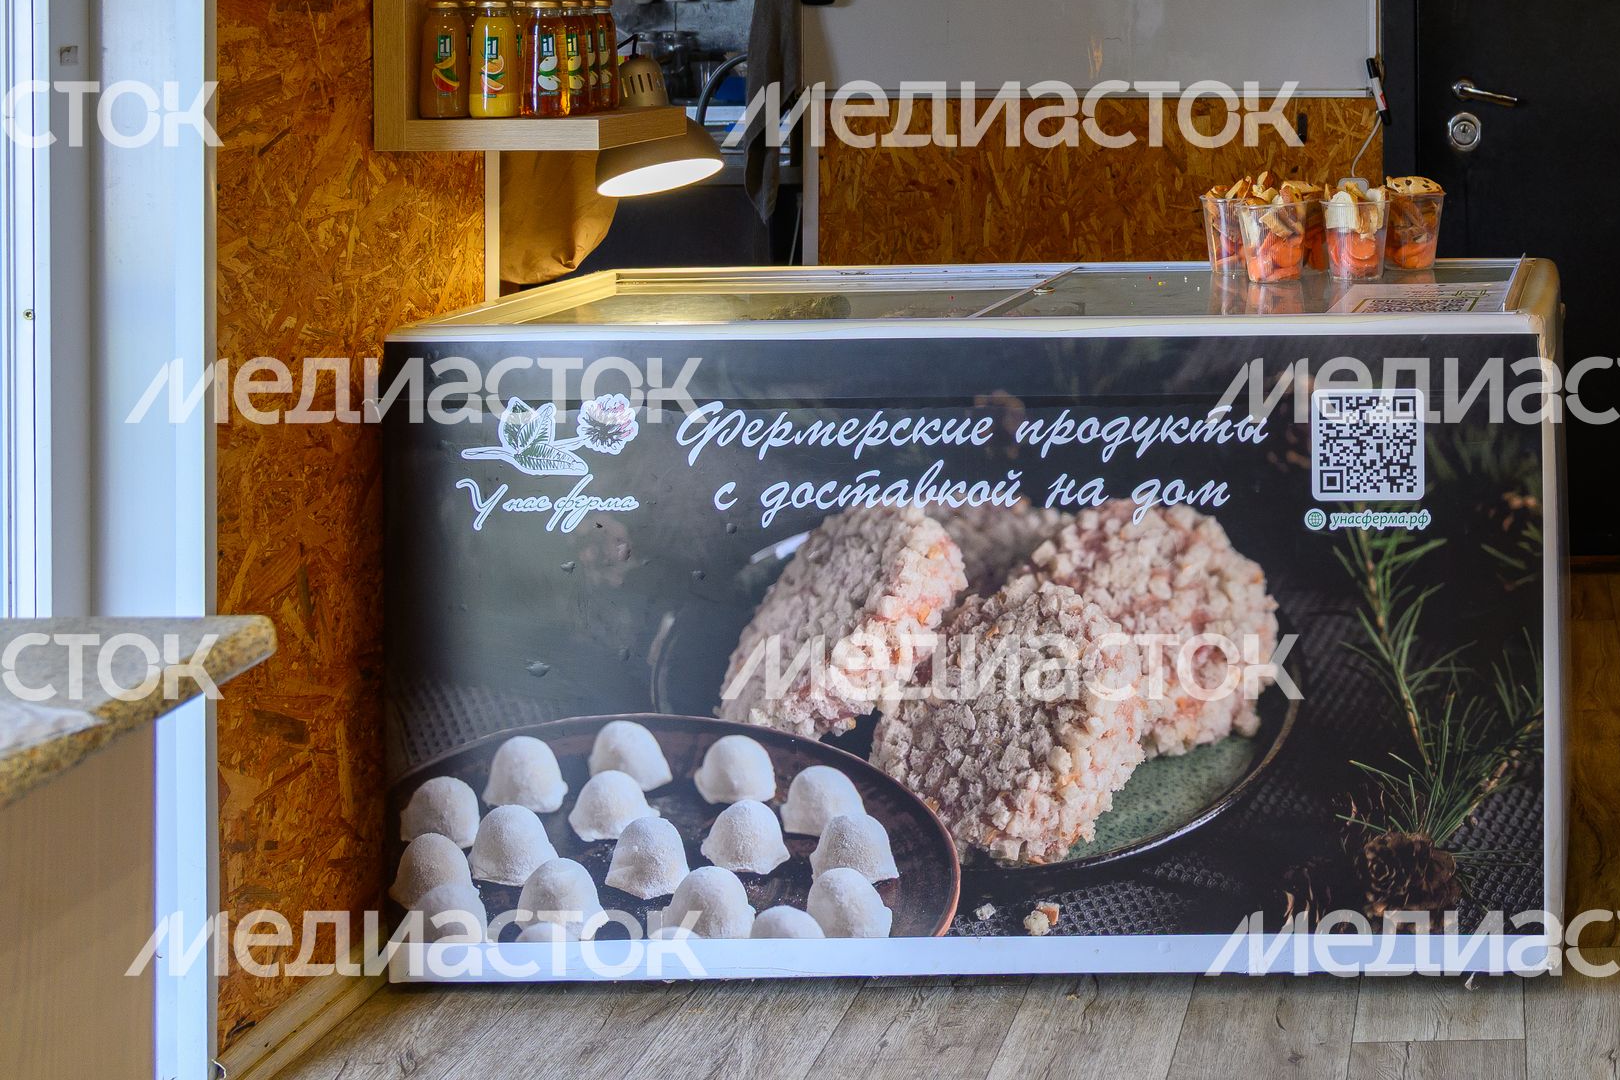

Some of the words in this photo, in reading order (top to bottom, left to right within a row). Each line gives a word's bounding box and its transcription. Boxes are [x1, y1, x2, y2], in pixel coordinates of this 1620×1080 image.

[675, 400, 994, 466] Фермерские
[1015, 404, 1268, 459] продукты
[714, 481, 738, 511] с
[760, 460, 1024, 528] доставкой
[1045, 472, 1109, 509] на
[1131, 476, 1230, 525] дом
[1329, 510, 1431, 530] унасферма.рф
